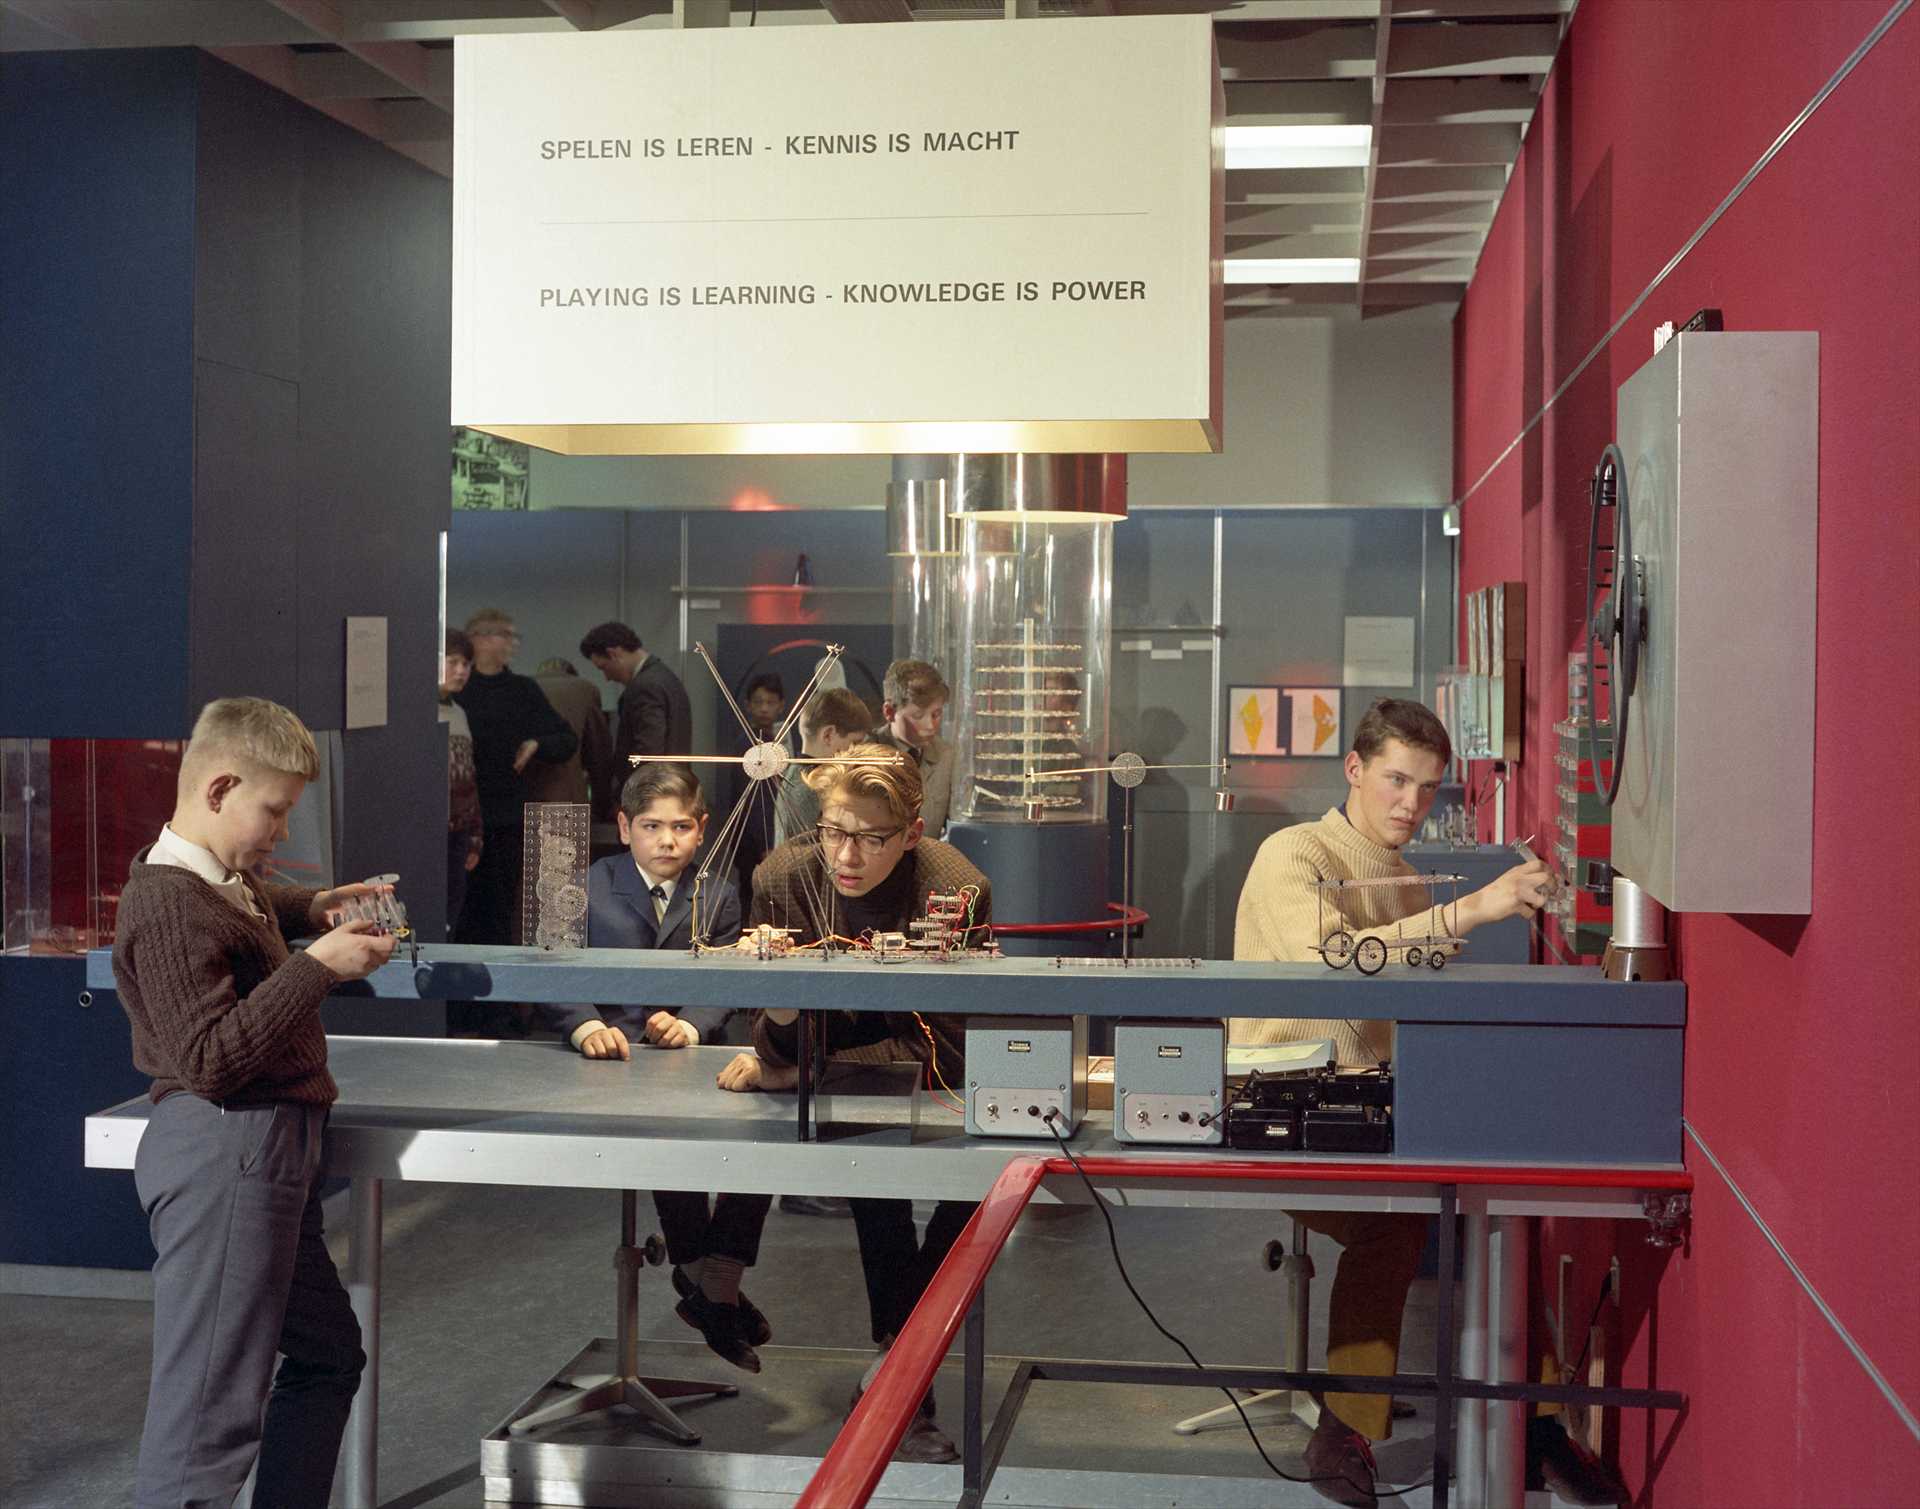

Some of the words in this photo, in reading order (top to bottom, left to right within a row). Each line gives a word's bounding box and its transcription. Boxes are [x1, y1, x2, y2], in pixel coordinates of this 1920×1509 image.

[540, 139, 632, 160] SPELEN
[643, 138, 665, 158] IS
[676, 137, 753, 157] LEREN
[785, 133, 878, 155] KENNIS
[888, 132, 911, 152] IS
[923, 130, 1020, 152] MACHT
[540, 287, 649, 308] PLAYING
[659, 286, 681, 306] IS
[692, 284, 815, 306] LEARNING
[843, 282, 1005, 304] KNOWLEDGE
[1016, 281, 1039, 302] IS
[1051, 280, 1146, 302] POWER
